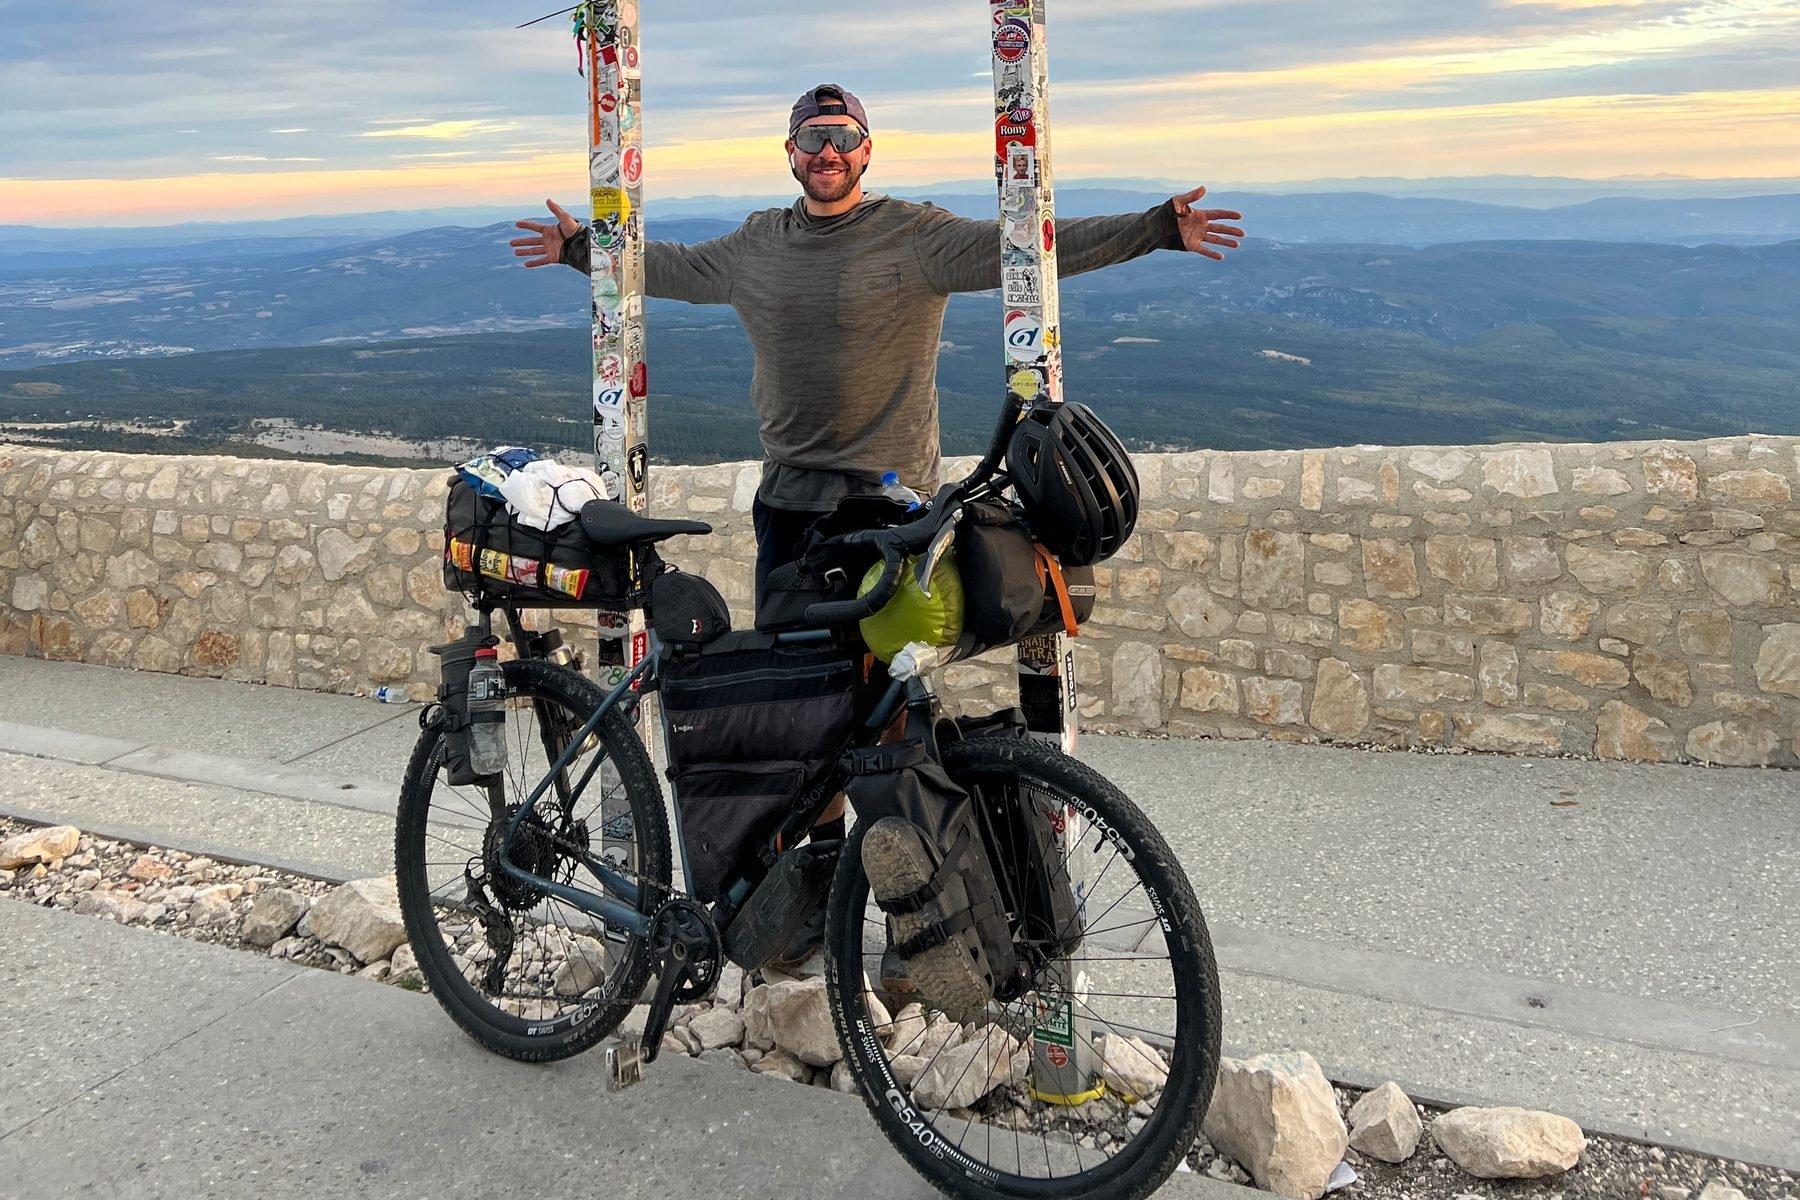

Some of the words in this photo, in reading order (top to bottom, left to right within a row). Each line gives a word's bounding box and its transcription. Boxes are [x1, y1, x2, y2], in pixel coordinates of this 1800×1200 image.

[1000, 125, 1027, 138] Romy
[1147, 886, 1165, 917] SWISS
[527, 1027, 538, 1036] DT
[861, 1037, 877, 1064] SWISS
